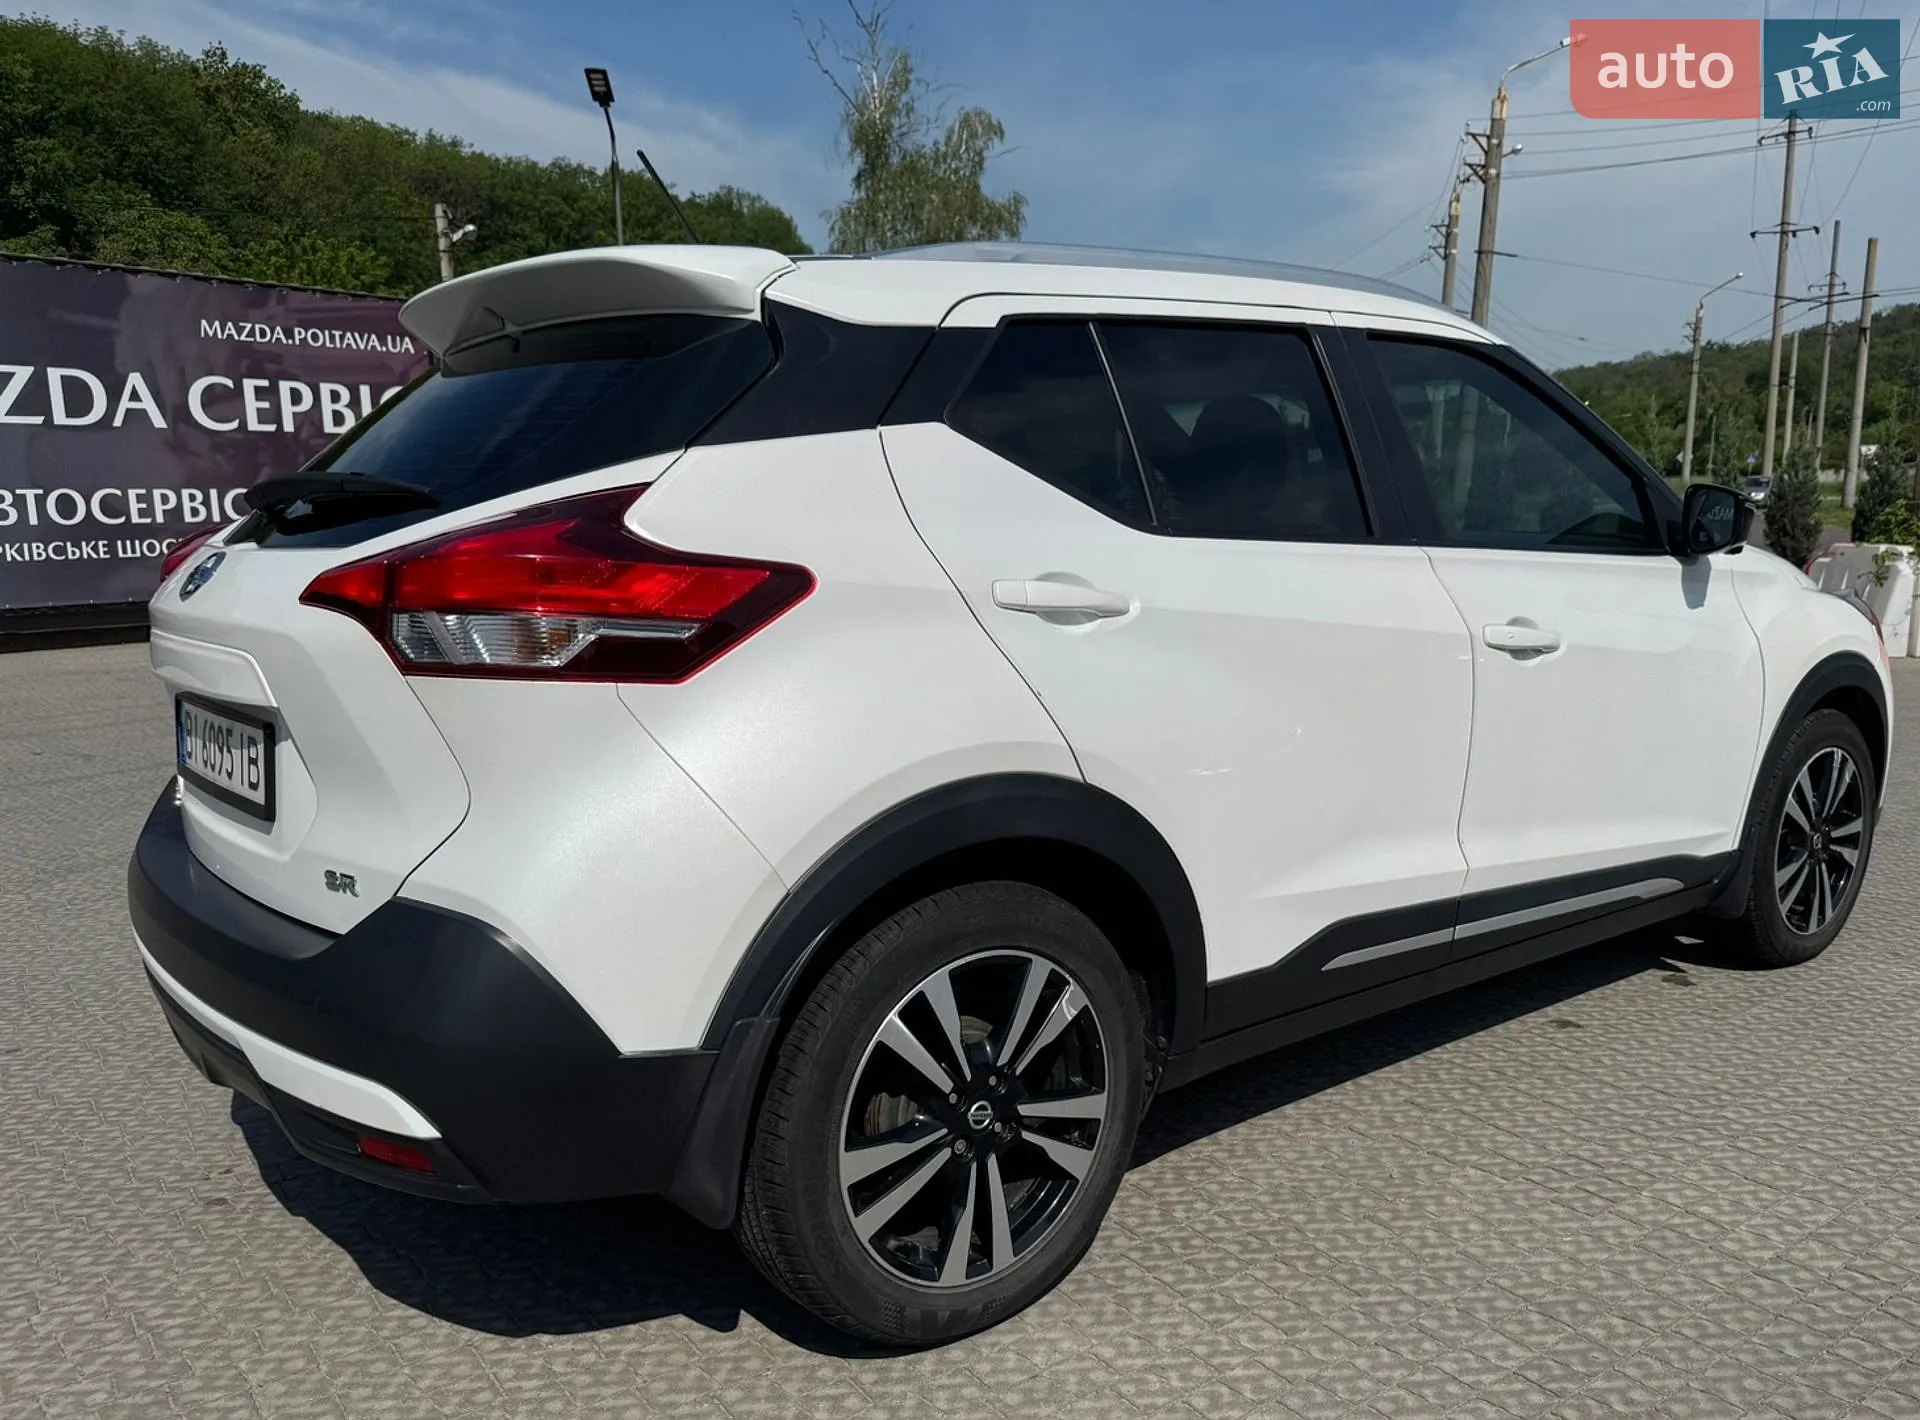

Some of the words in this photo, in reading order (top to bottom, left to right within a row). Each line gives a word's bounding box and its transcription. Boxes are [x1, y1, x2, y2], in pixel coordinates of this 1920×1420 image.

[200, 319, 415, 354] MAZDA.POLTAVA.UA
[186, 375, 404, 434] СЕРВІ
[0, 541, 111, 562] КІВСЬКЕ
[116, 538, 184, 558] ШОС
[202, 718, 234, 781] 6095
[324, 867, 360, 898] SR
